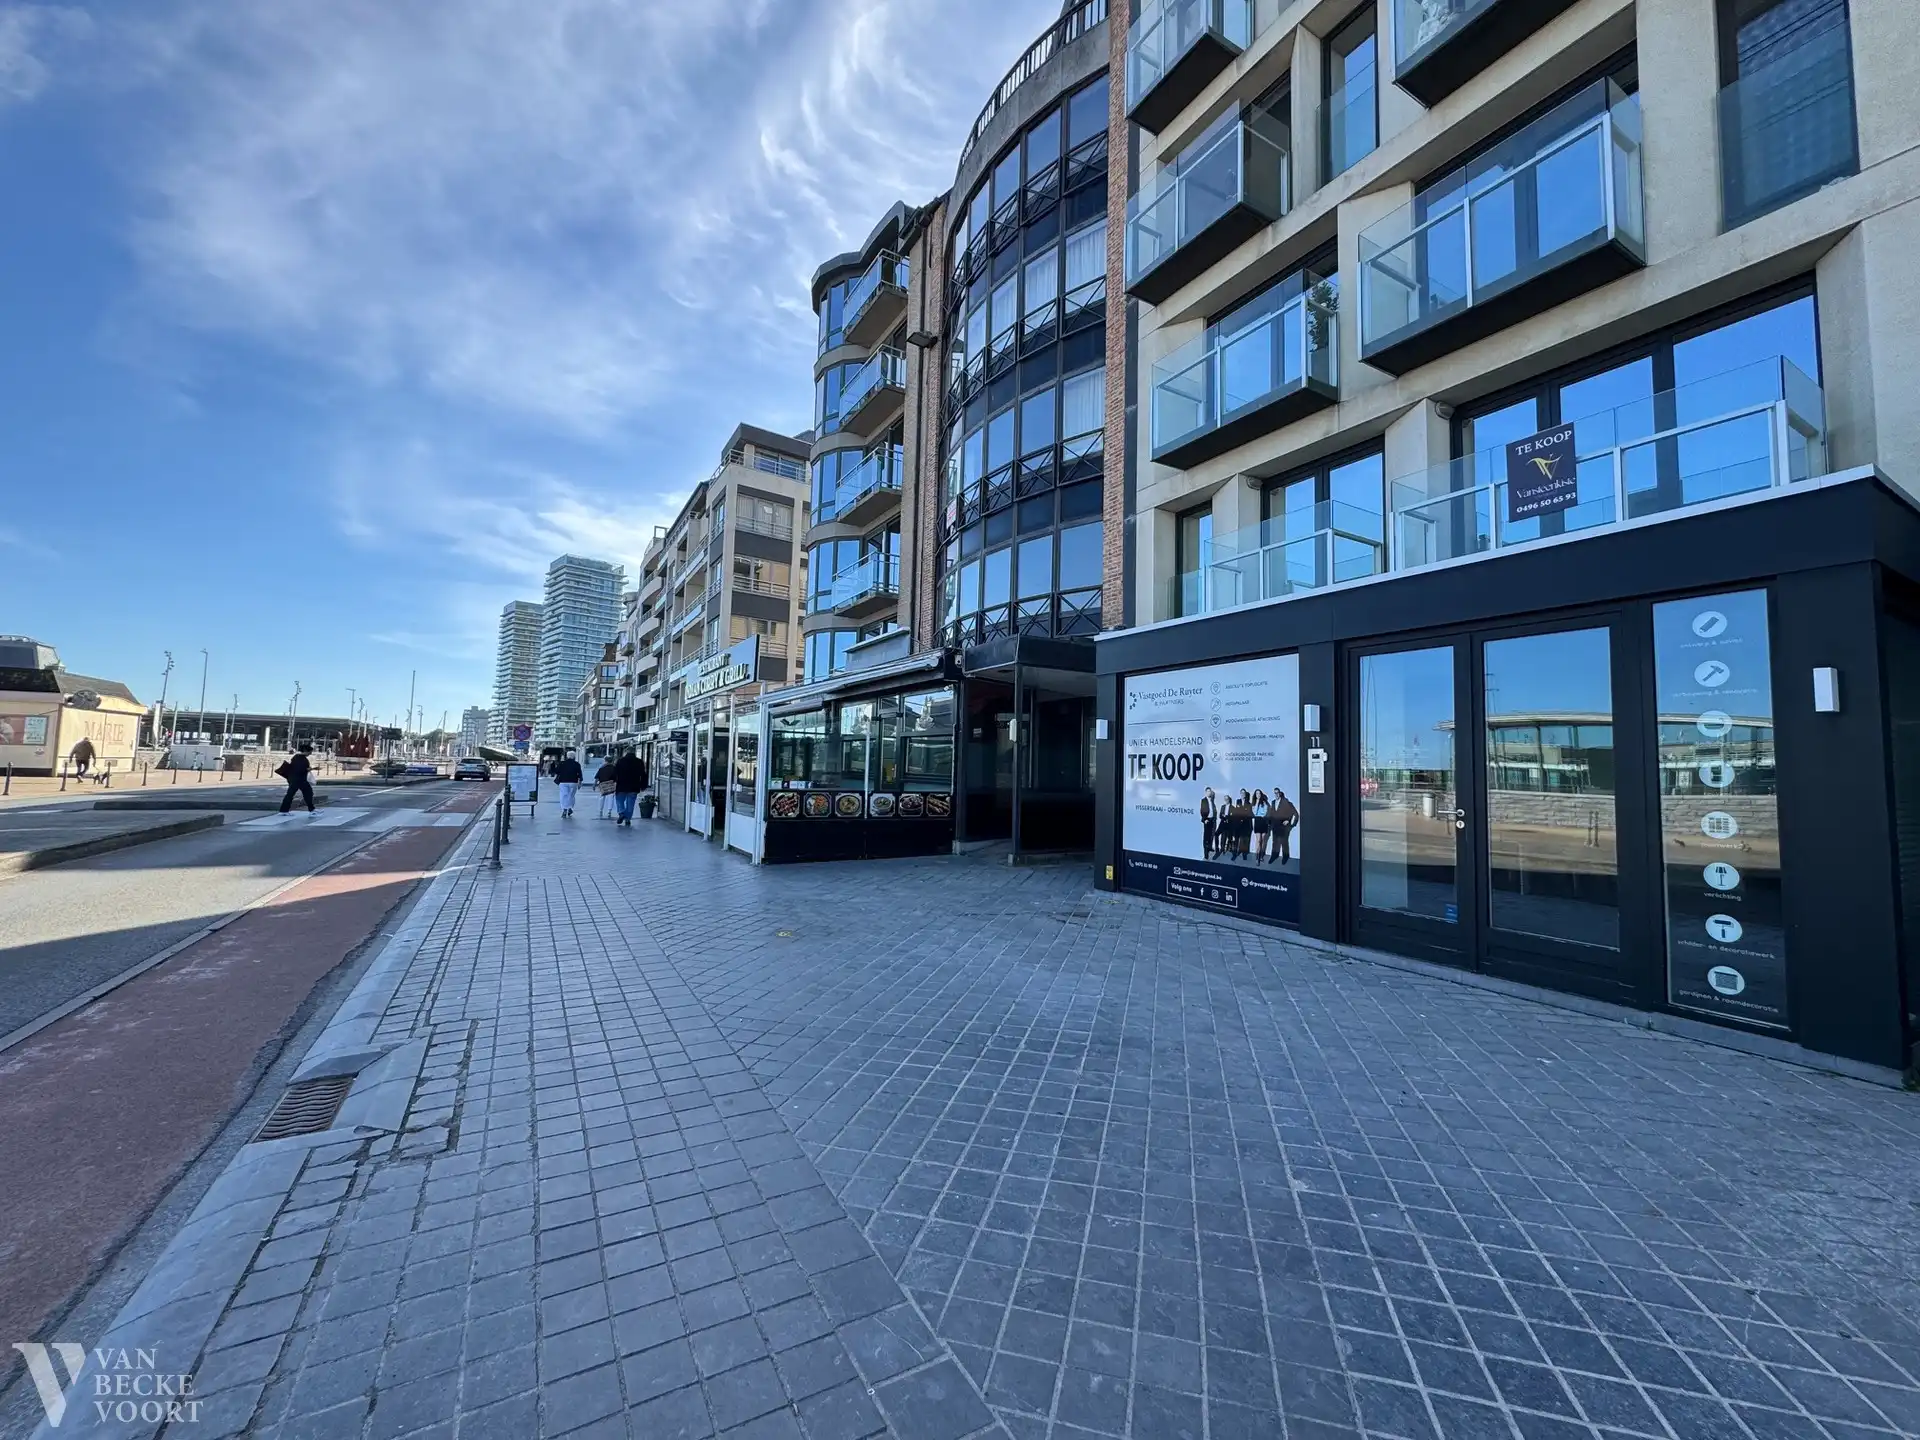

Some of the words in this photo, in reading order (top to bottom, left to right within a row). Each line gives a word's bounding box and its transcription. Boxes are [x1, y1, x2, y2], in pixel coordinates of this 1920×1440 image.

[1516, 443, 1532, 456] TE
[1535, 430, 1572, 450] KOOP
[1516, 503, 1539, 512] 0496
[1540, 499, 1551, 507] 50
[1552, 495, 1564, 503] 65
[1139, 689, 1167, 702] Vastgoed
[1168, 688, 1178, 697] De
[1180, 687, 1203, 698] Ruyter
[85, 721, 124, 741] MARIE
[1128, 739, 1148, 747] UNIEK
[1150, 736, 1204, 746] HANDELSPAND
[1310, 736, 1320, 748] 11
[1128, 754, 1147, 780] TE
[1152, 753, 1204, 781] KOOP
[1168, 806, 1194, 815] OOSTENDE
[1171, 882, 1182, 892] Volg
